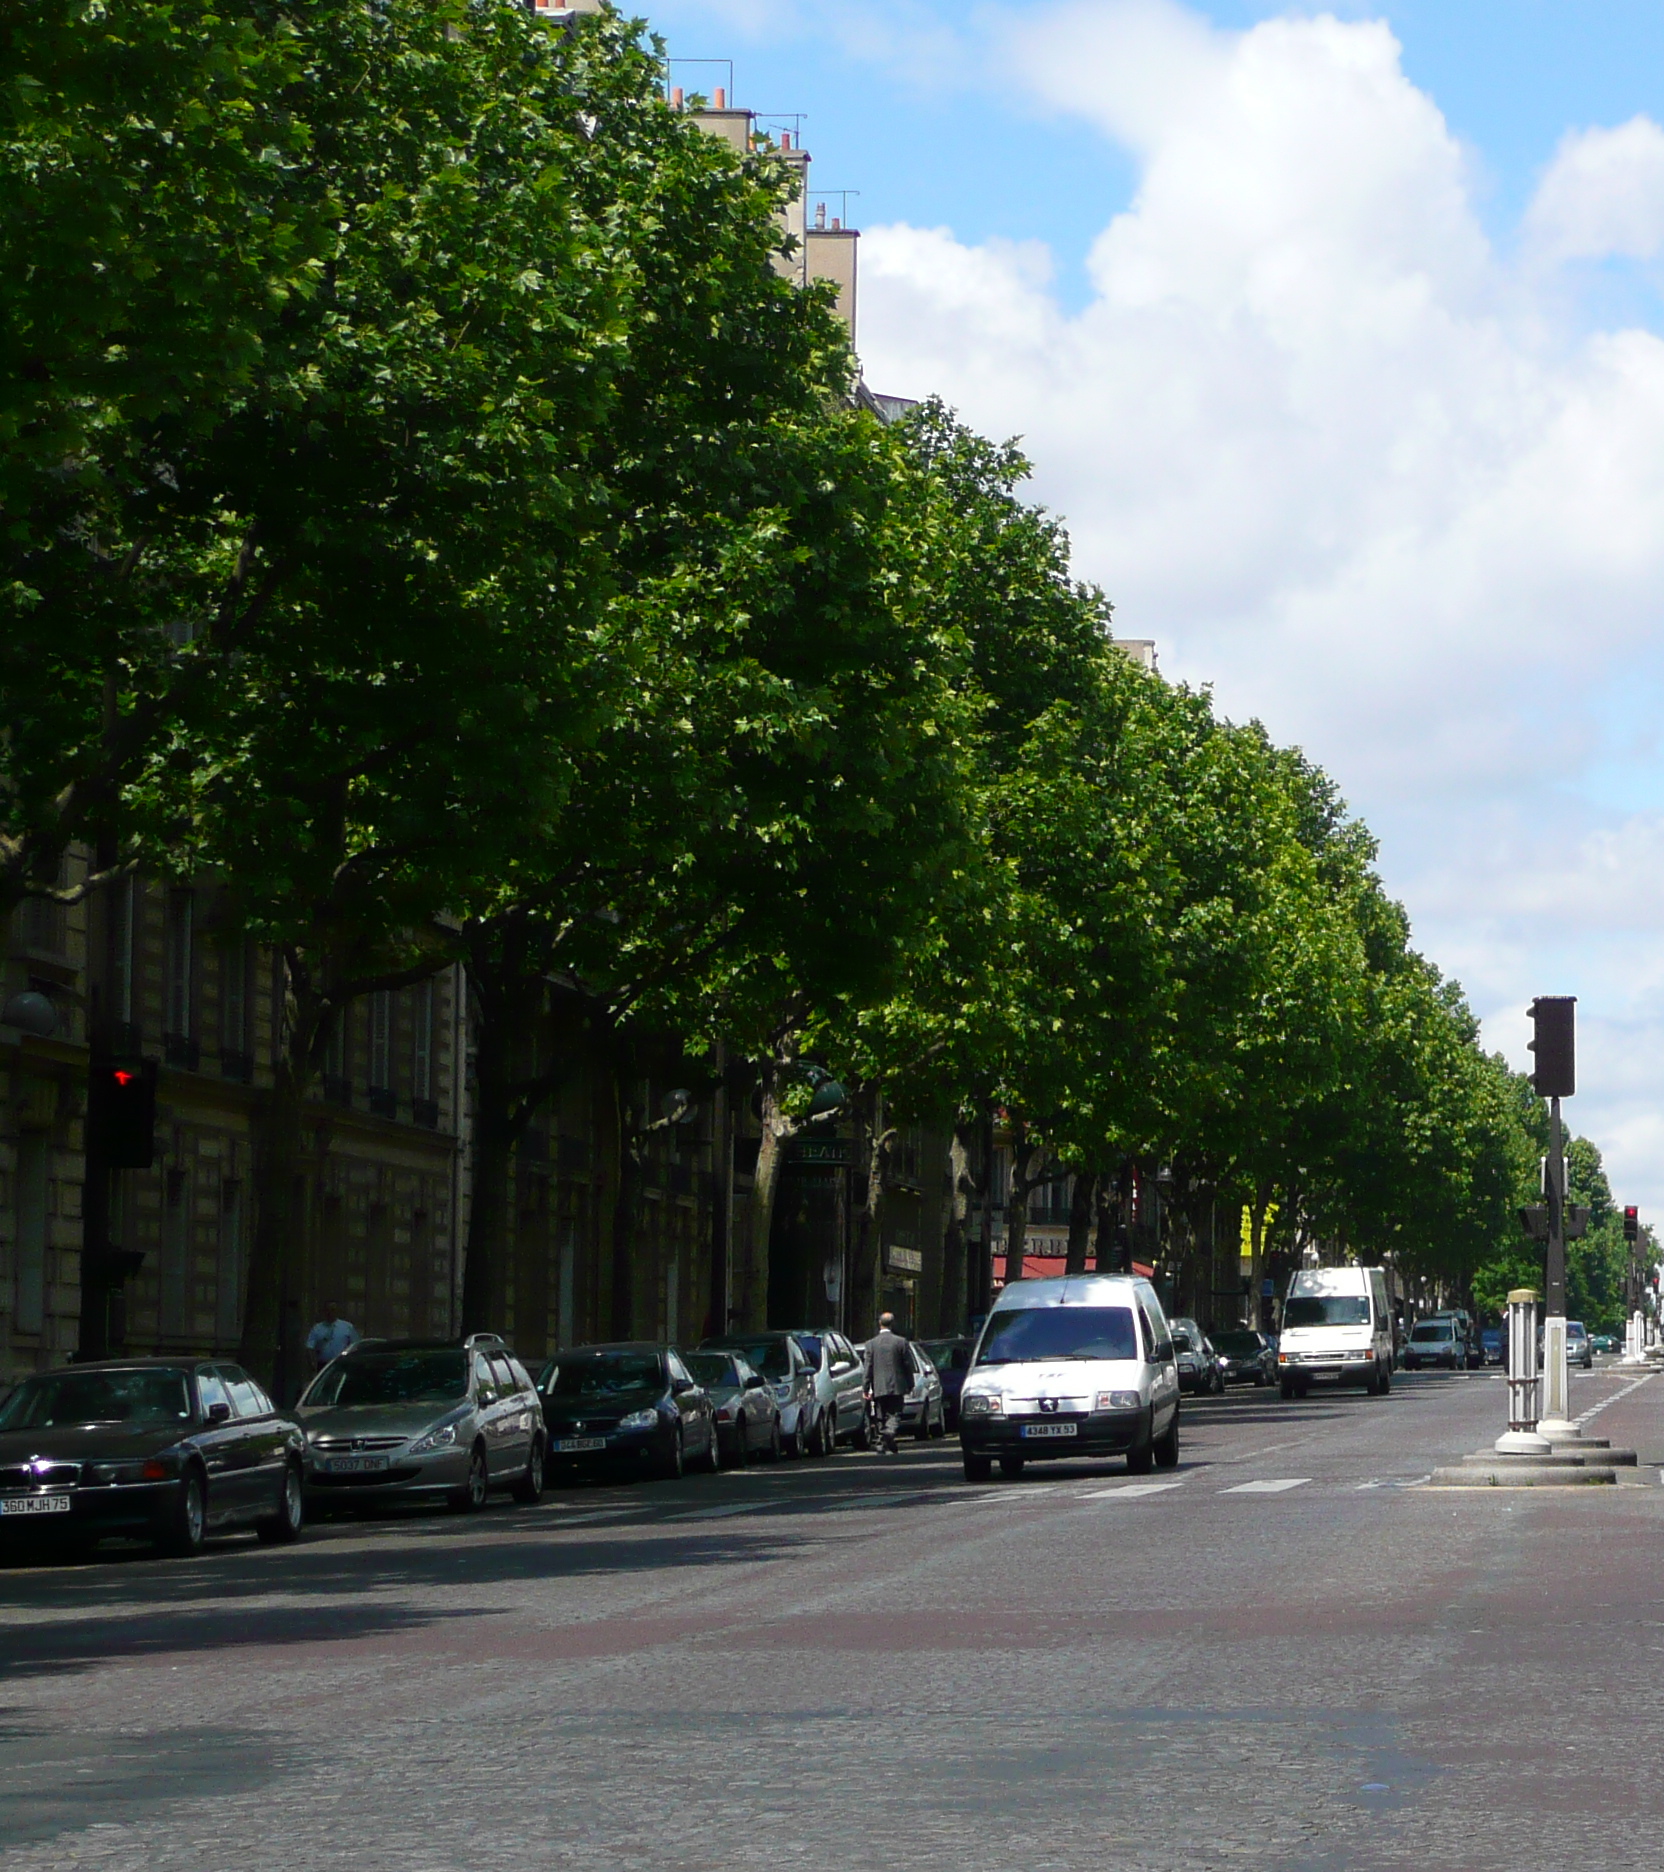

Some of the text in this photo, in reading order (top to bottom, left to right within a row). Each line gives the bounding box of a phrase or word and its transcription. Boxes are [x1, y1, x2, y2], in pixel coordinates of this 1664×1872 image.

[2, 1498, 68, 1513] 360 MJH 75
